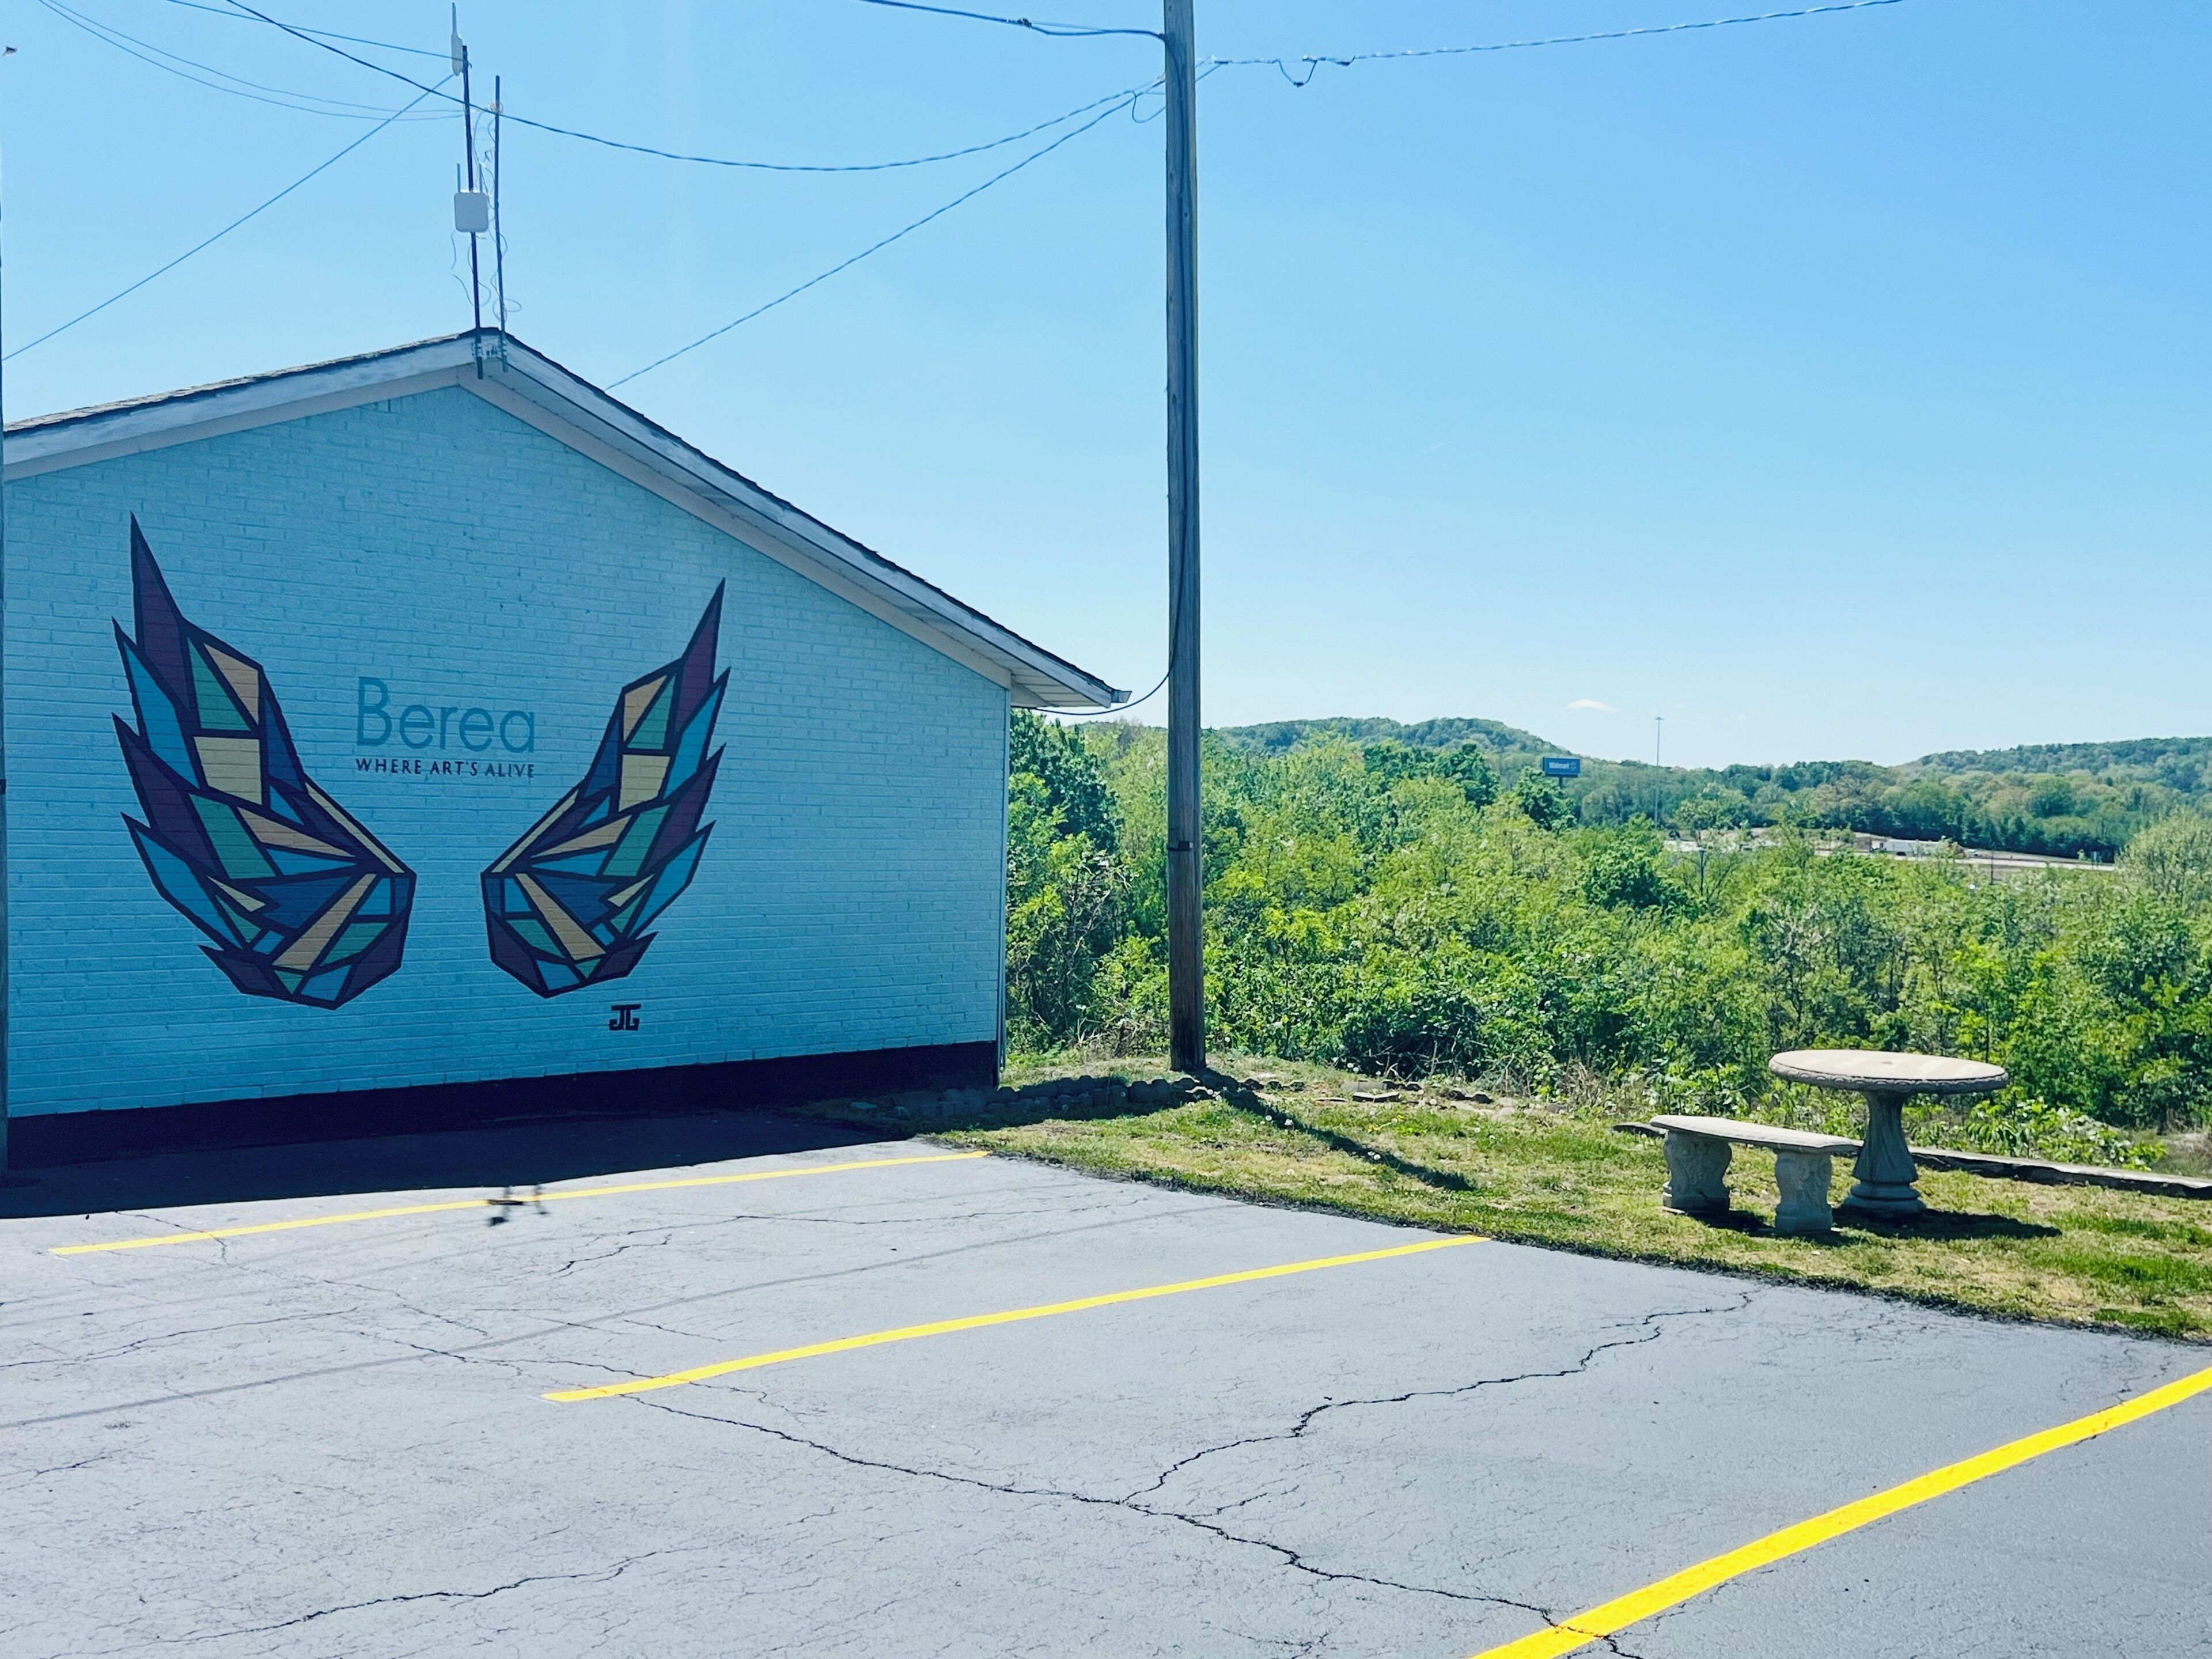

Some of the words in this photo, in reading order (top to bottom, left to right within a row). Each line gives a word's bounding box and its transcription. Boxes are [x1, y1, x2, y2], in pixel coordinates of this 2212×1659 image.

[357, 676, 535, 753] Berea
[355, 757, 422, 774] WHERE
[430, 761, 478, 777] ART'S
[484, 763, 535, 778] ALIVE
